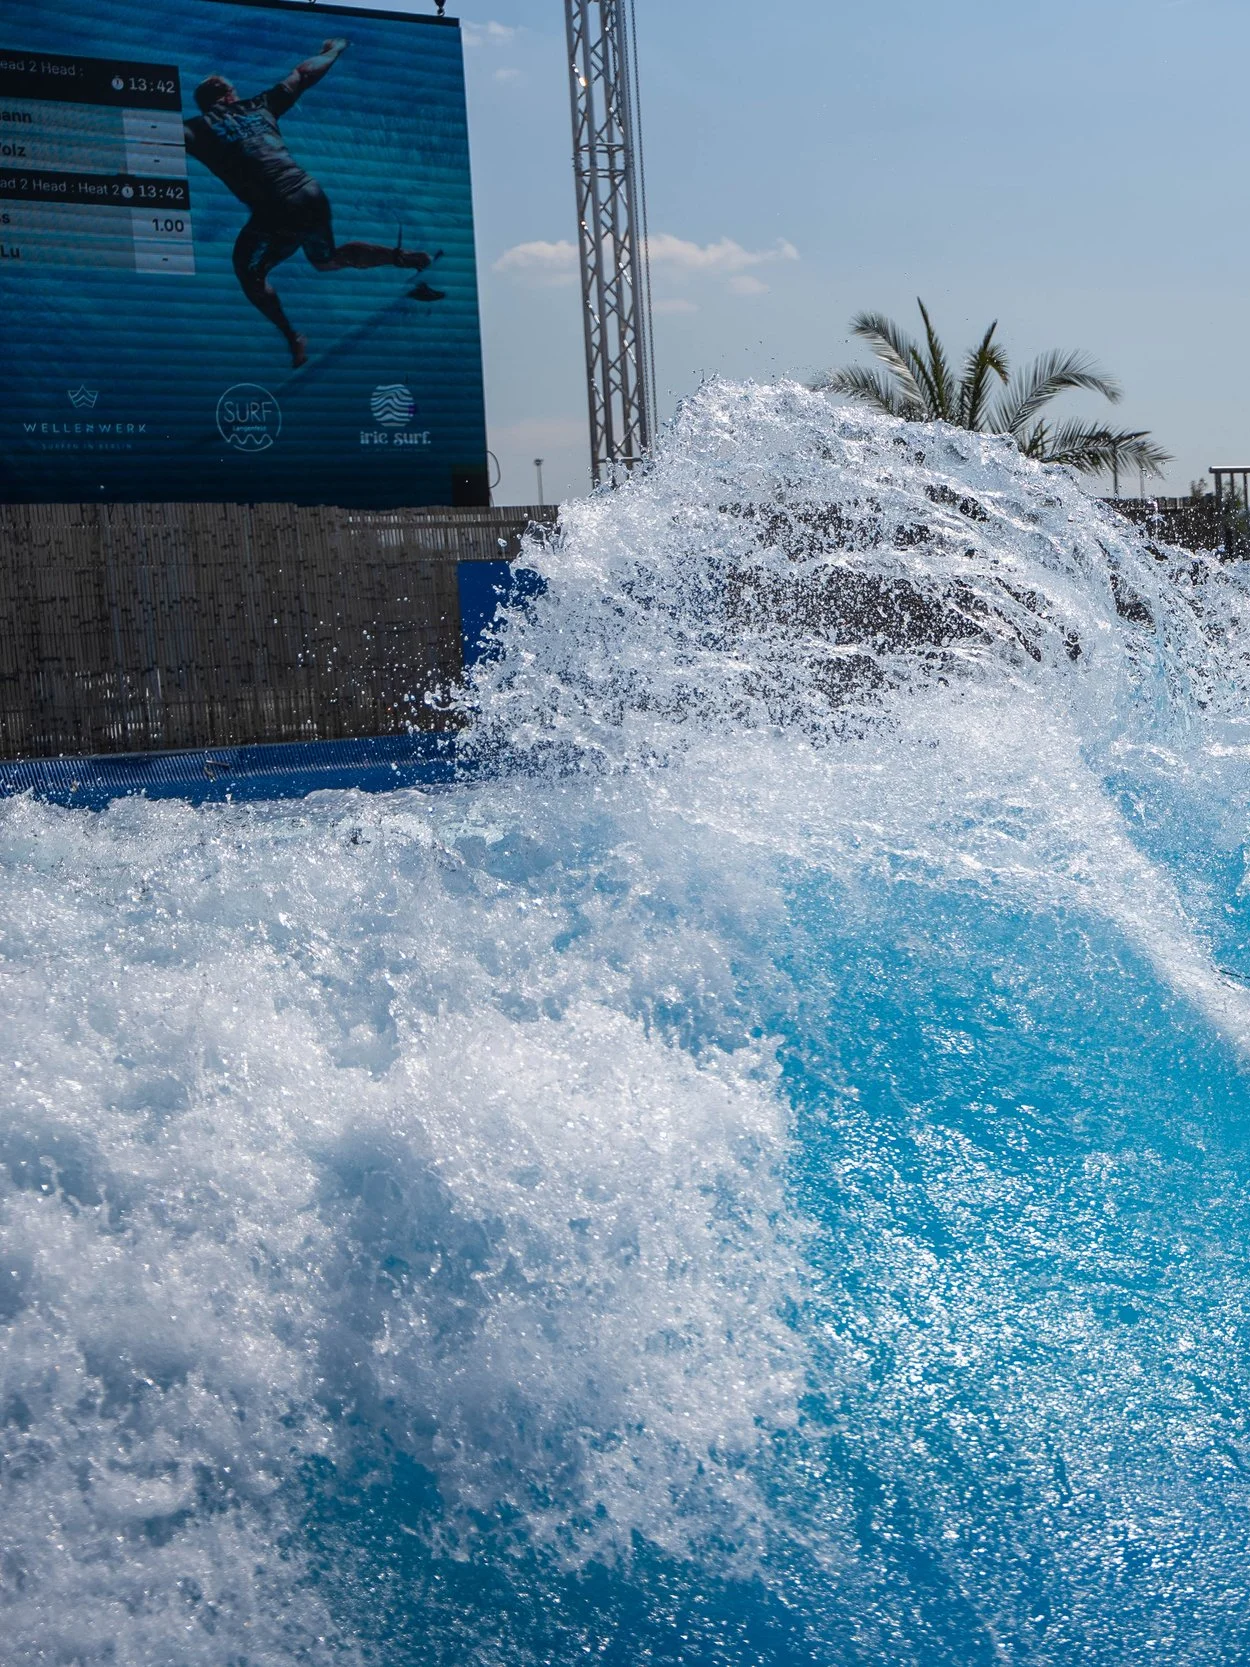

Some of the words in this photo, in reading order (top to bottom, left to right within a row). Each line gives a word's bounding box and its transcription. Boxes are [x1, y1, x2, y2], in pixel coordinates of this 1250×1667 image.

[0, 60, 25, 72] ead
[29, 60, 37, 73] 2
[41, 61, 76, 76] Head
[129, 77, 176, 94] 13:42
[0, 112, 32, 124] ann
[0, 141, 27, 158] olz
[20, 178, 28, 191] 2
[32, 179, 67, 193] Head
[78, 182, 109, 196] Heat
[112, 184, 120, 197] 2
[138, 186, 185, 200] 13:42
[152, 218, 184, 233] 1.00
[223, 400, 273, 423] SURF
[23, 422, 147, 434] WELLENWERK
[360, 430, 389, 445] irie
